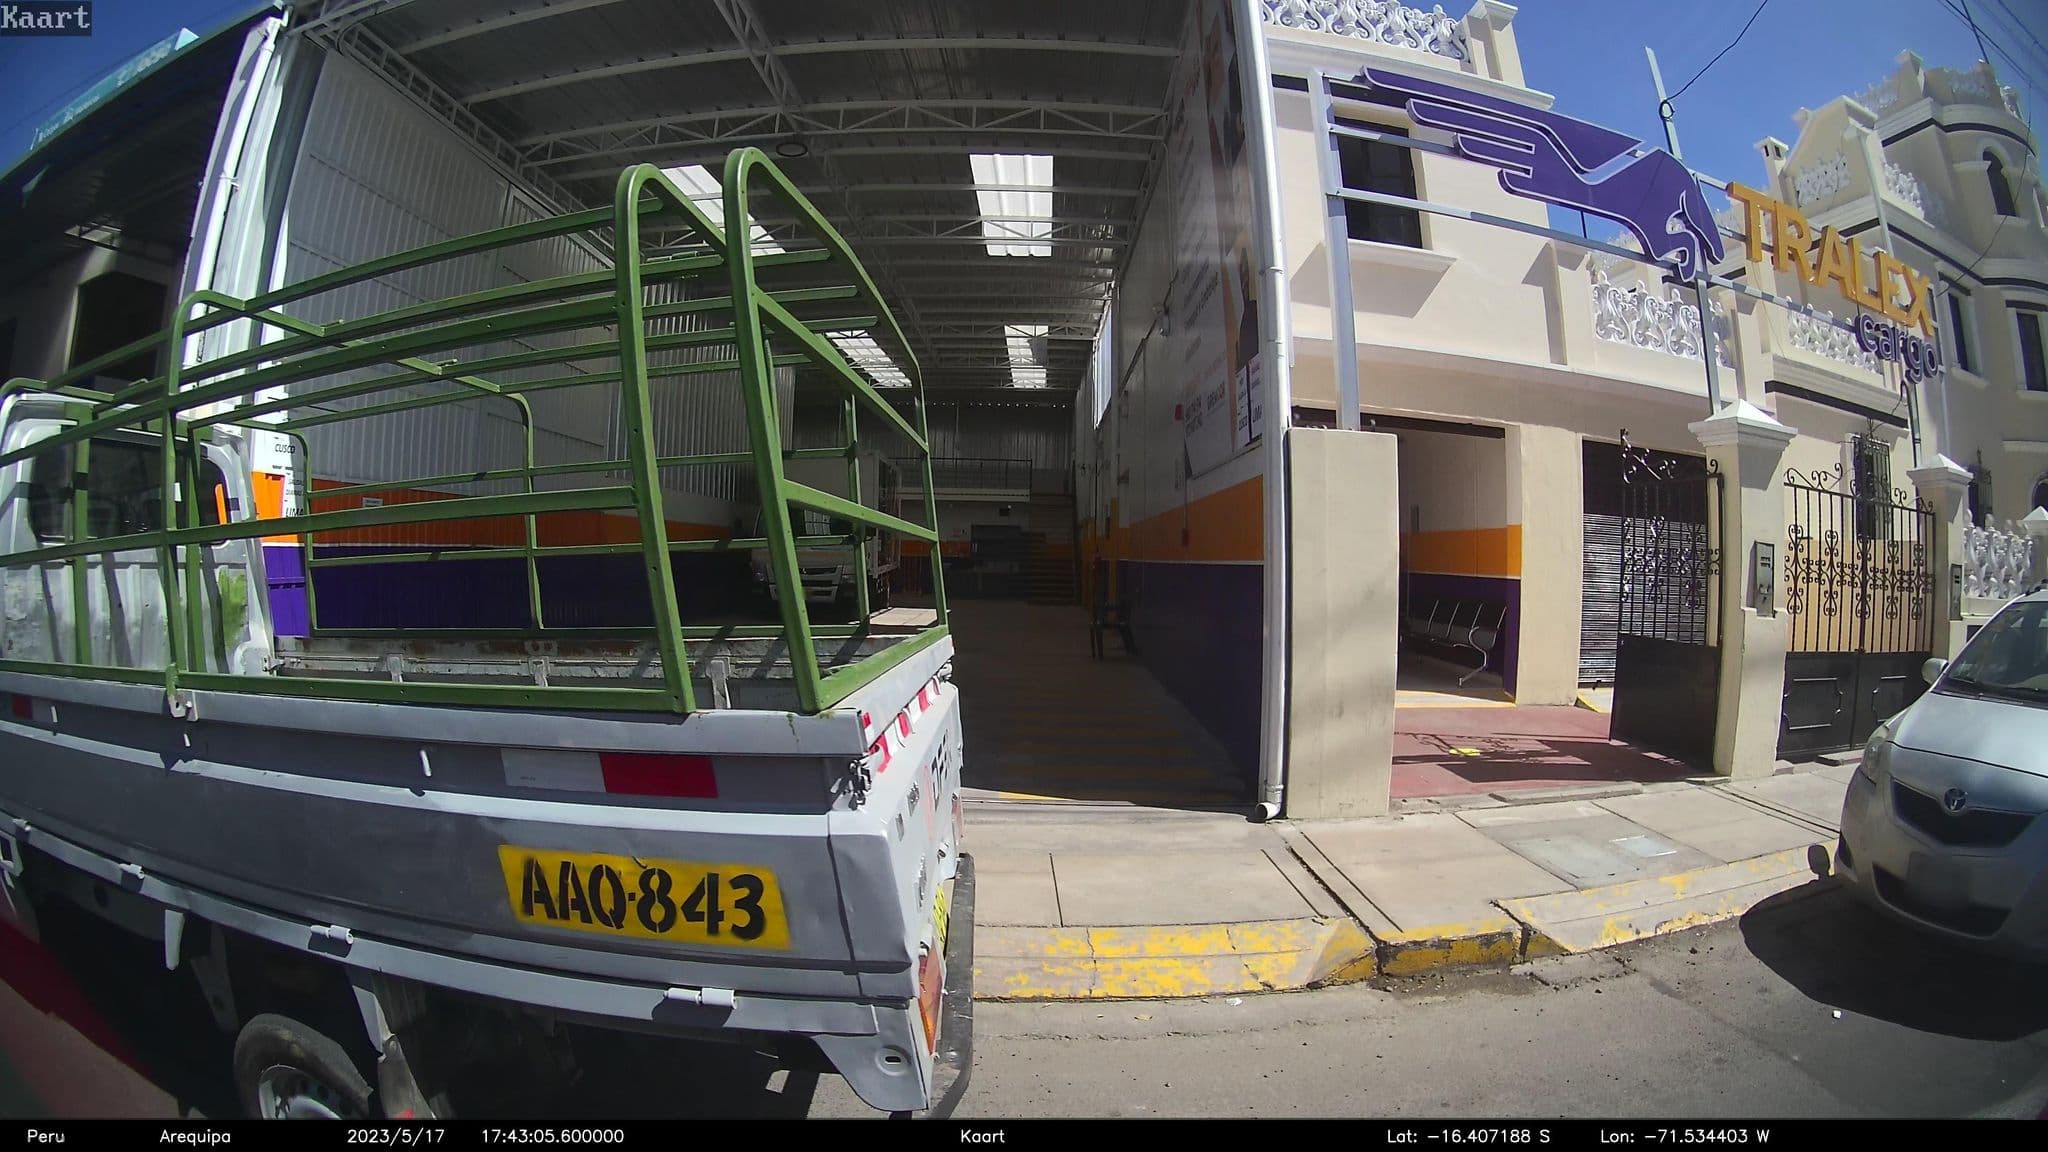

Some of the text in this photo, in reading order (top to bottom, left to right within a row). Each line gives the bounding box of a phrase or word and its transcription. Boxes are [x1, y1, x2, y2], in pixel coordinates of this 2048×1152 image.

[1726, 181, 1934, 336] TRALEX
[1854, 315, 1938, 384] cargo
[274, 443, 296, 454] CUSCO
[522, 857, 765, 940] AAQ-843
